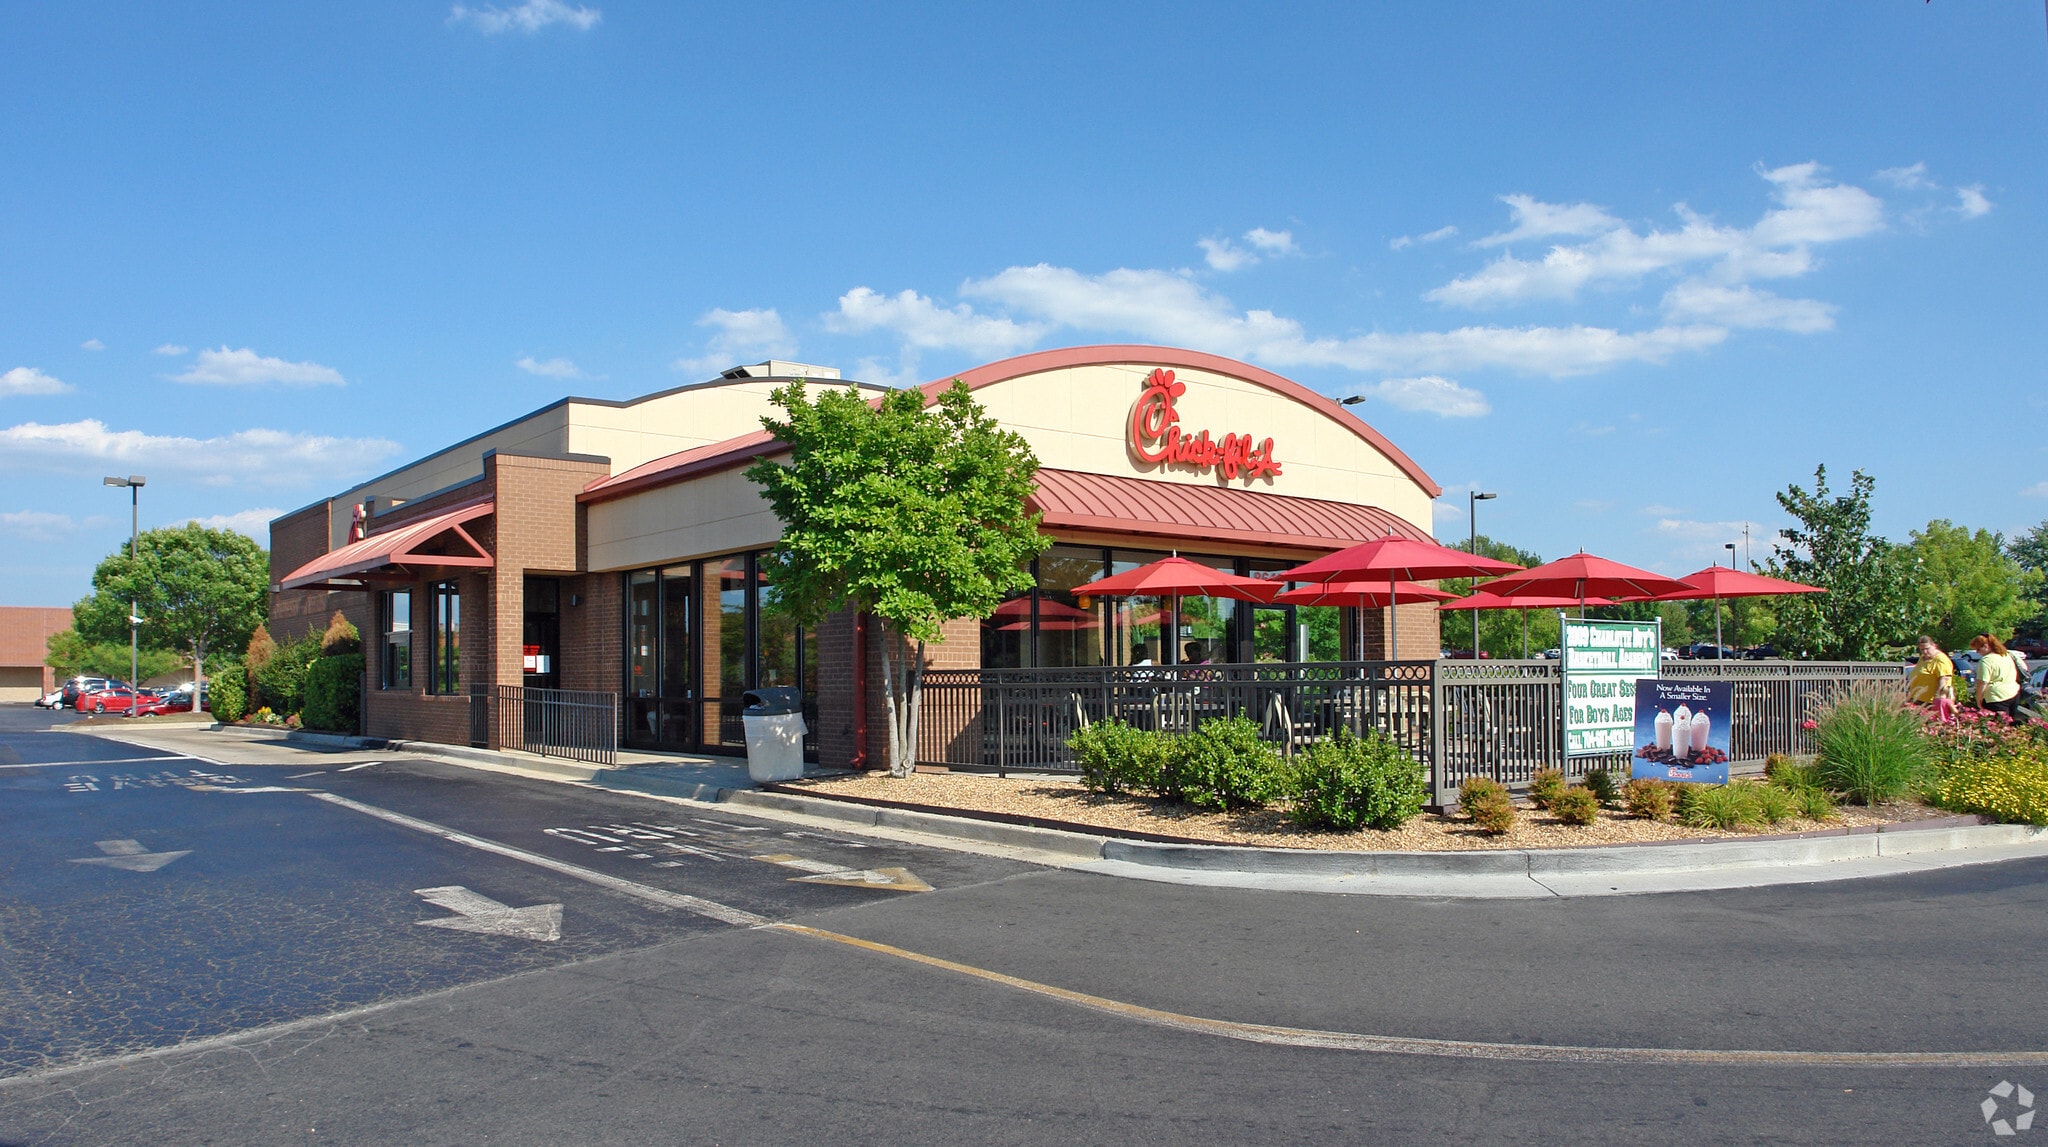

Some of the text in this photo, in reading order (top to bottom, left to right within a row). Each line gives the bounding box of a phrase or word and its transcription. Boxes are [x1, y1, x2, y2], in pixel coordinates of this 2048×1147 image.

[1133, 368, 1283, 480] Chick-fil-A
[1656, 683, 1711, 693] Now Available In
[1659, 692, 1666, 700] A
[1667, 692, 1691, 700] Smaller
